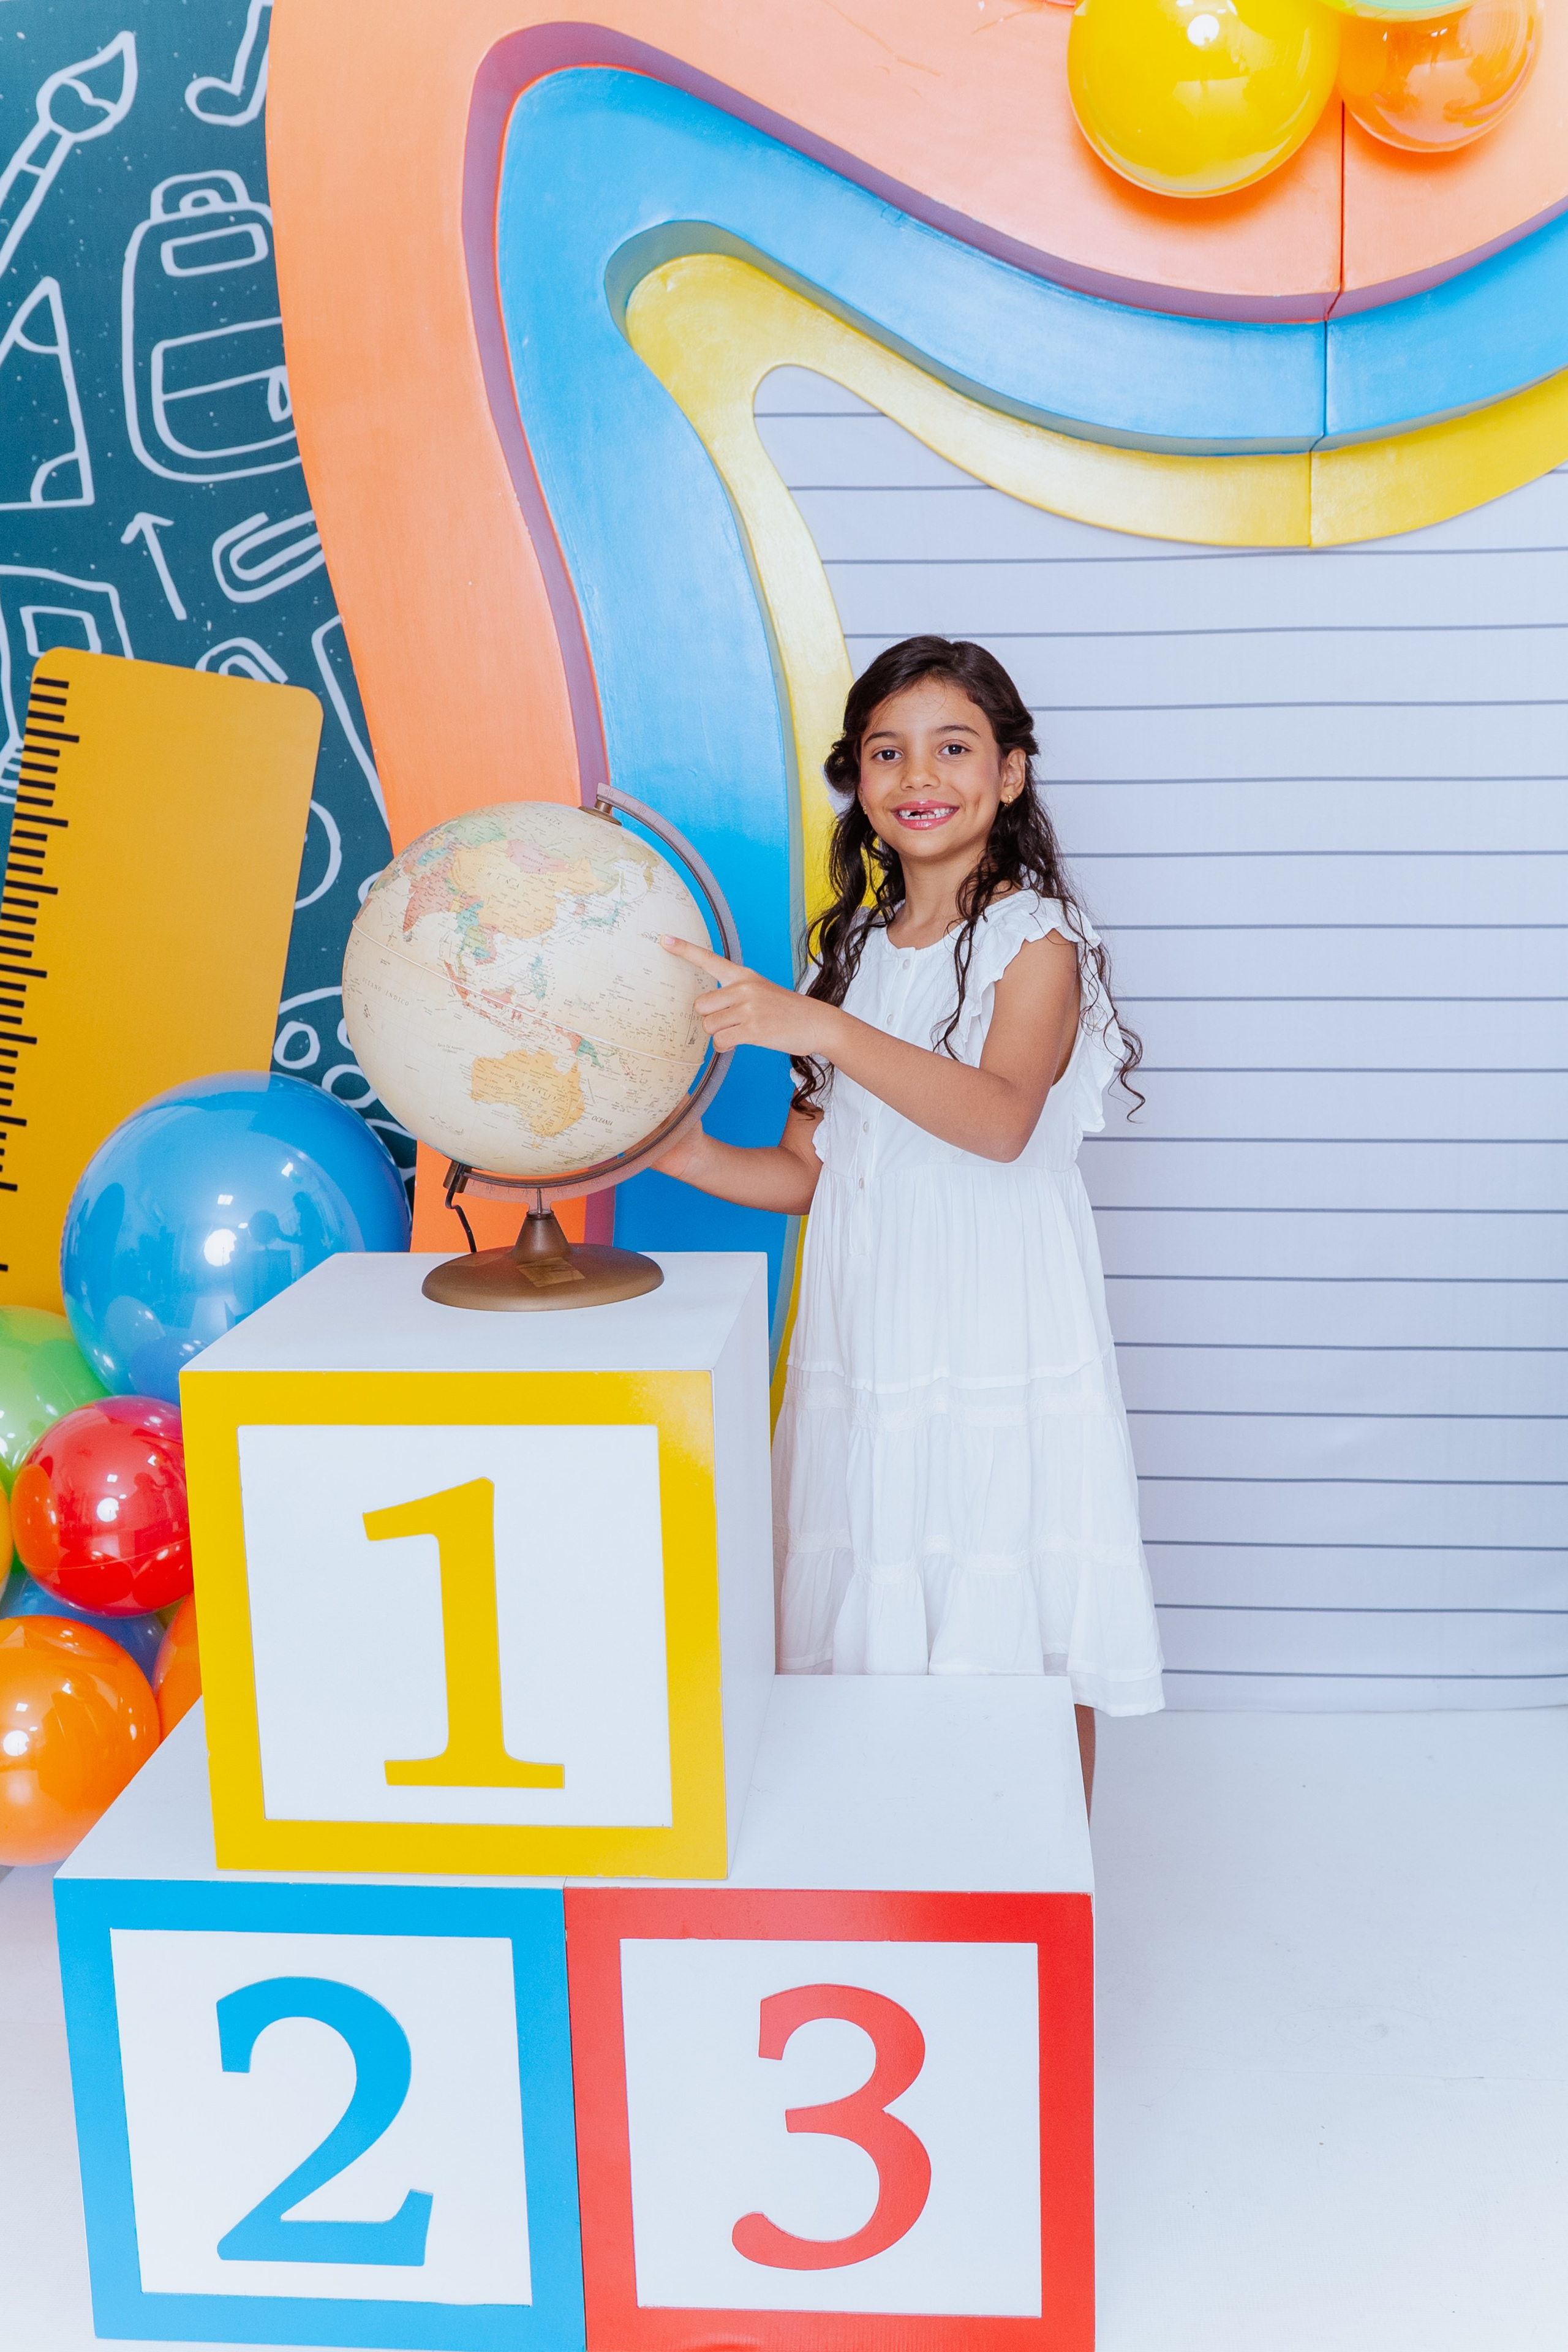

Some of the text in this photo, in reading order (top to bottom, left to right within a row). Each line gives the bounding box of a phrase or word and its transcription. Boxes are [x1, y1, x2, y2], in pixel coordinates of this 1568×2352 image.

[478, 867, 520, 889] CHINA
[362, 977, 382, 992] OCEANO
[508, 1079, 558, 1101] AUSTRALIA
[590, 1115, 614, 1126] OCEANIA
[362, 1477, 565, 1790] 1
[216, 1975, 434, 2267] 2
[731, 1983, 932, 2271] 3
